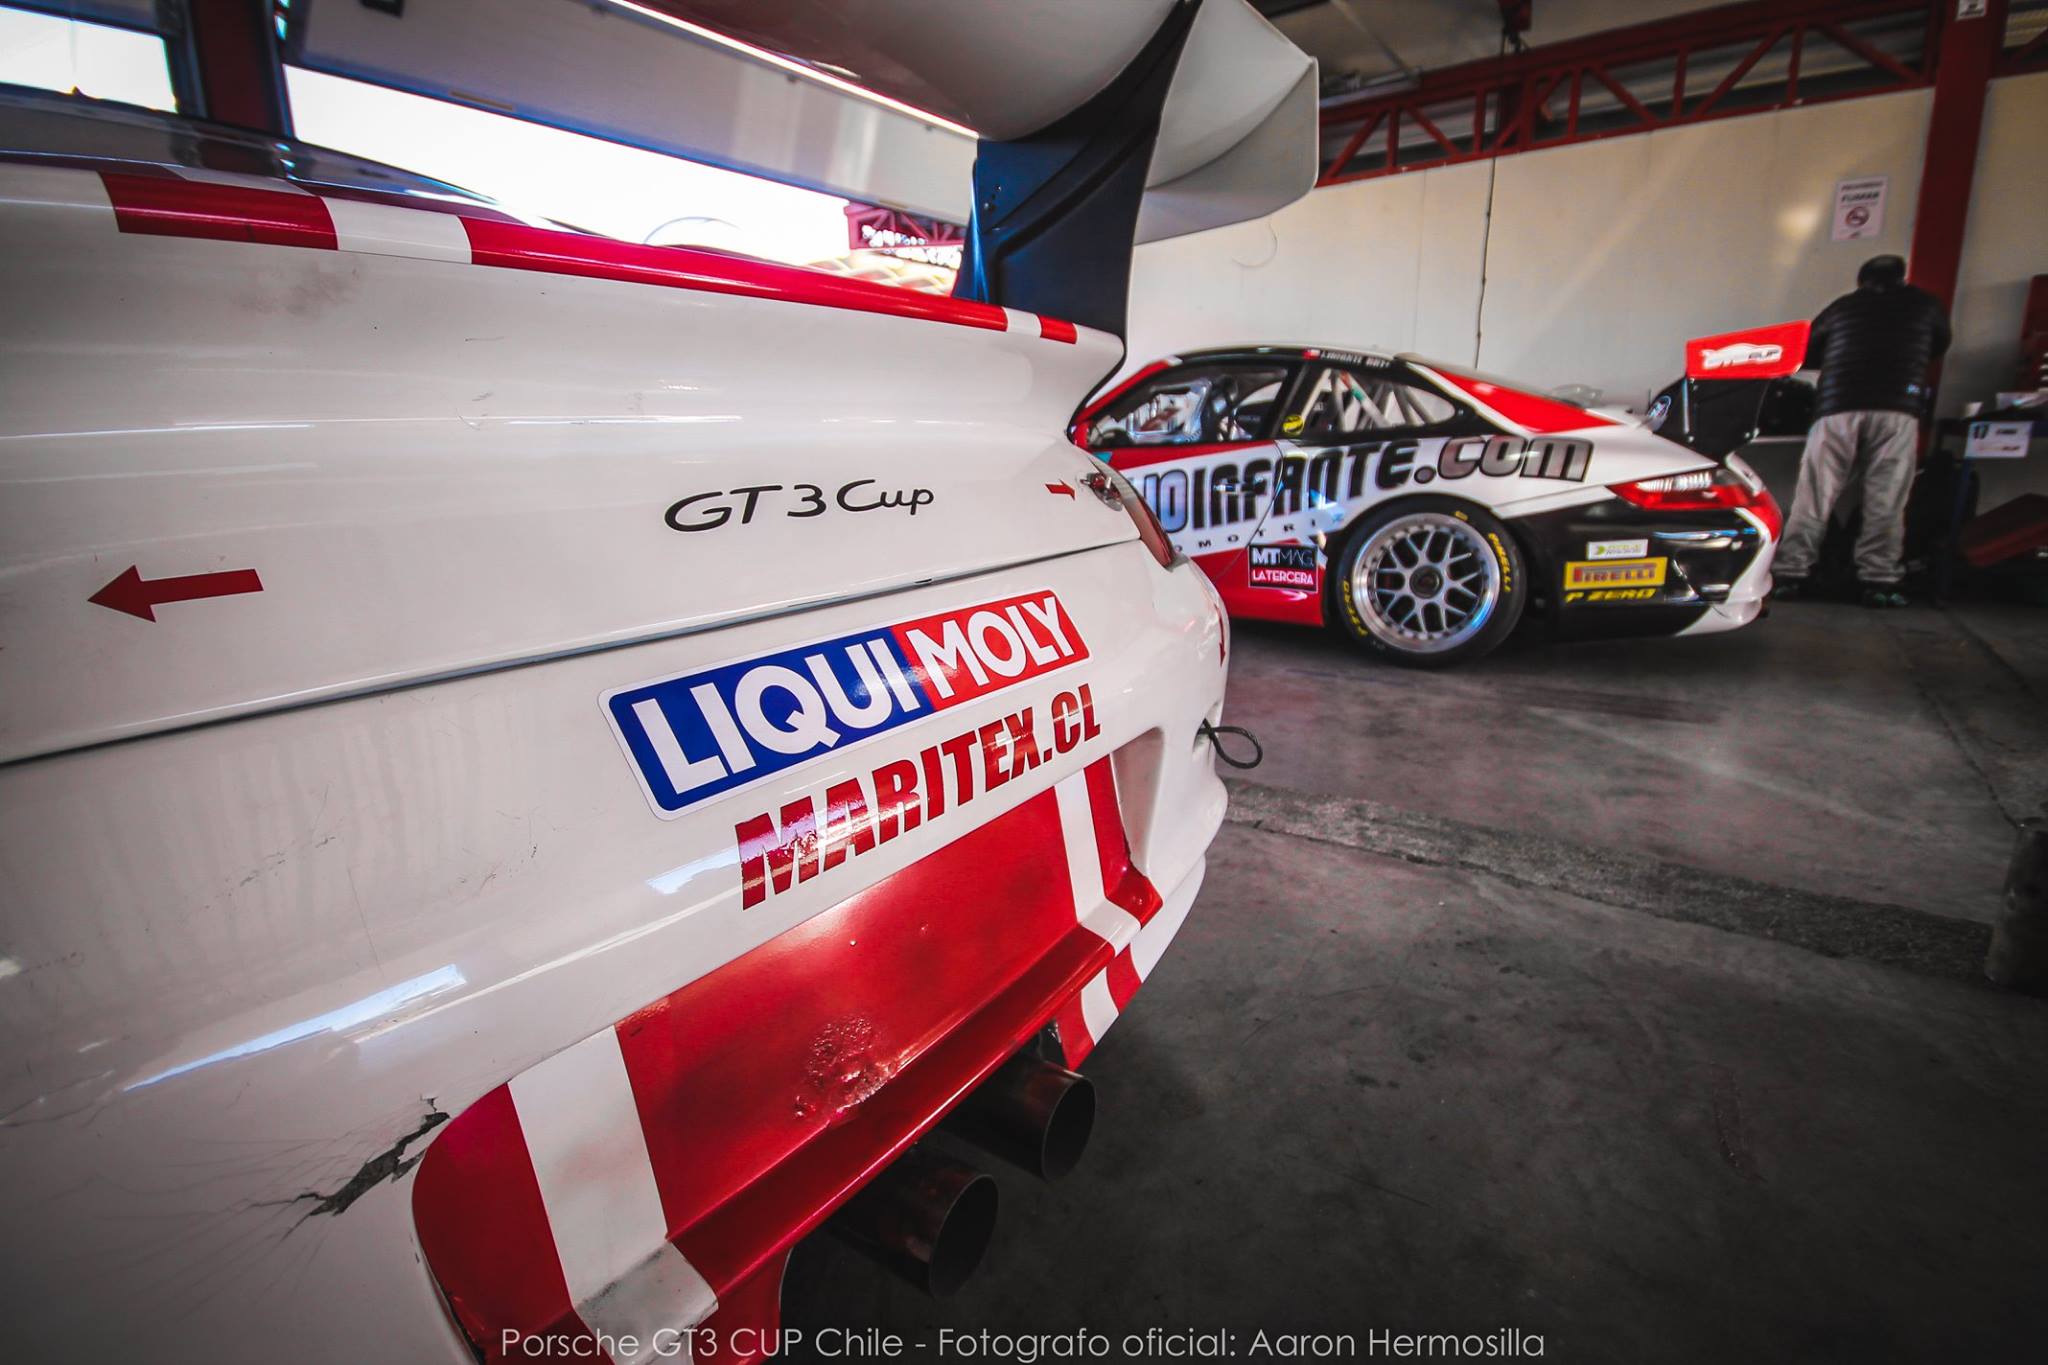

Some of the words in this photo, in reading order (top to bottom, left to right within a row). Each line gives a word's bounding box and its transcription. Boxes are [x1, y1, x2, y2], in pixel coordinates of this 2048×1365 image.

[836, 479, 935, 516] Cup
[1573, 563, 1657, 583] PIRELLI
[631, 638, 921, 795] LIQUI
[905, 596, 1075, 700] MOLY
[734, 683, 1101, 911] MARITEX.CL
